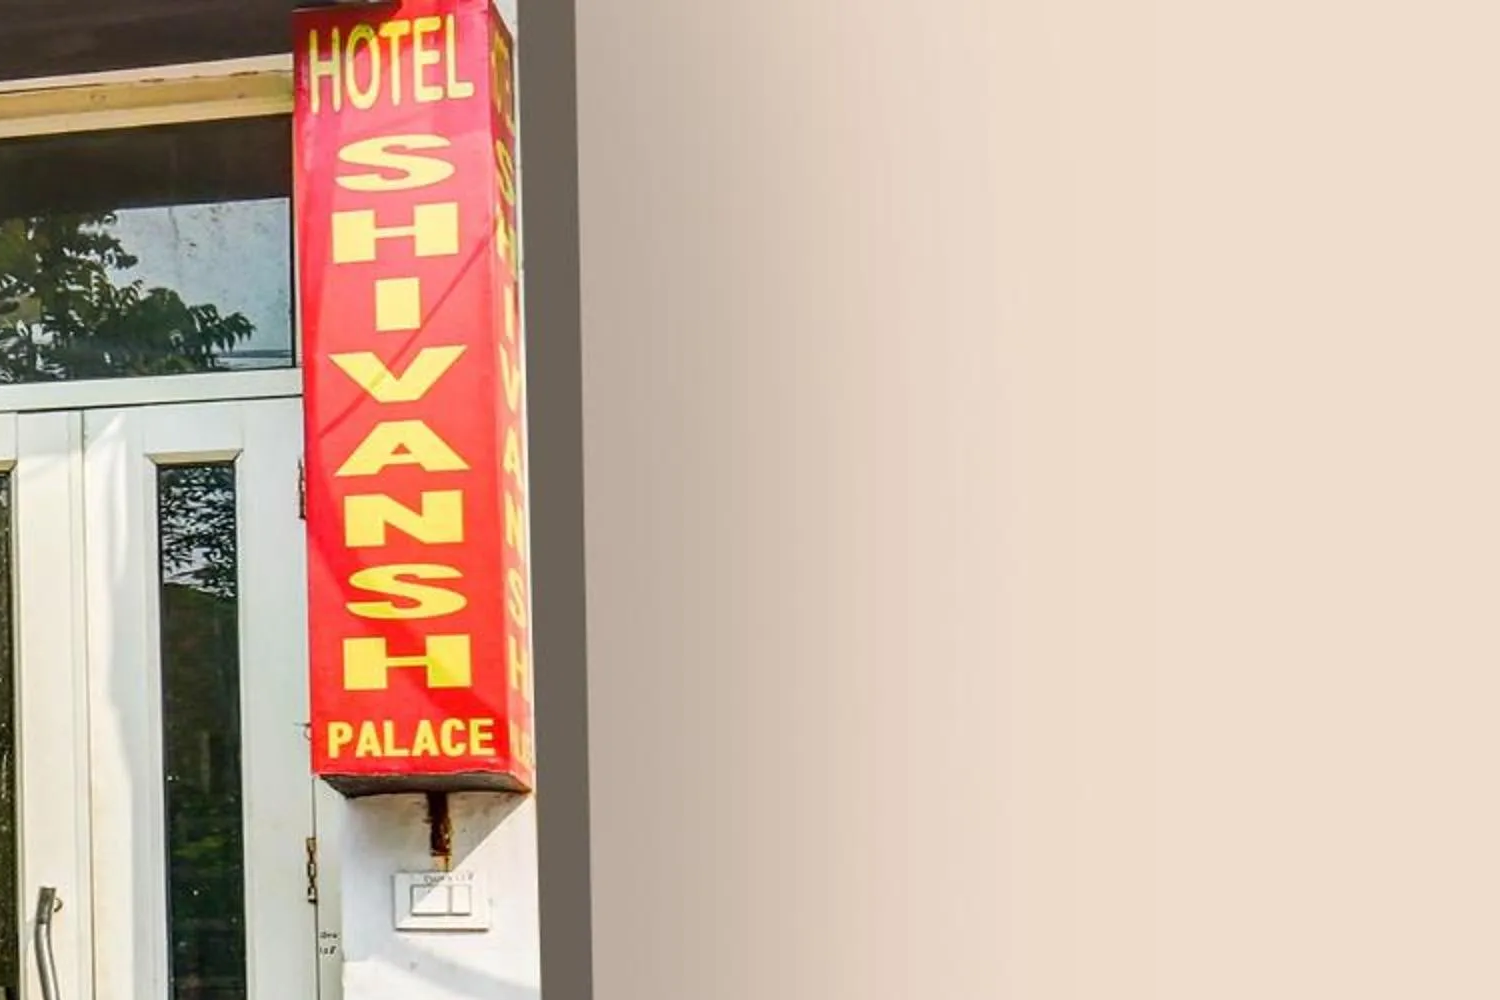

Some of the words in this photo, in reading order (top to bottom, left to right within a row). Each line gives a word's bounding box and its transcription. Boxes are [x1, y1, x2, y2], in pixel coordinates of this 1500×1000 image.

[308, 14, 474, 114] HOTEL
[328, 134, 473, 691] SHIVANSH
[326, 719, 497, 758] PALACE
